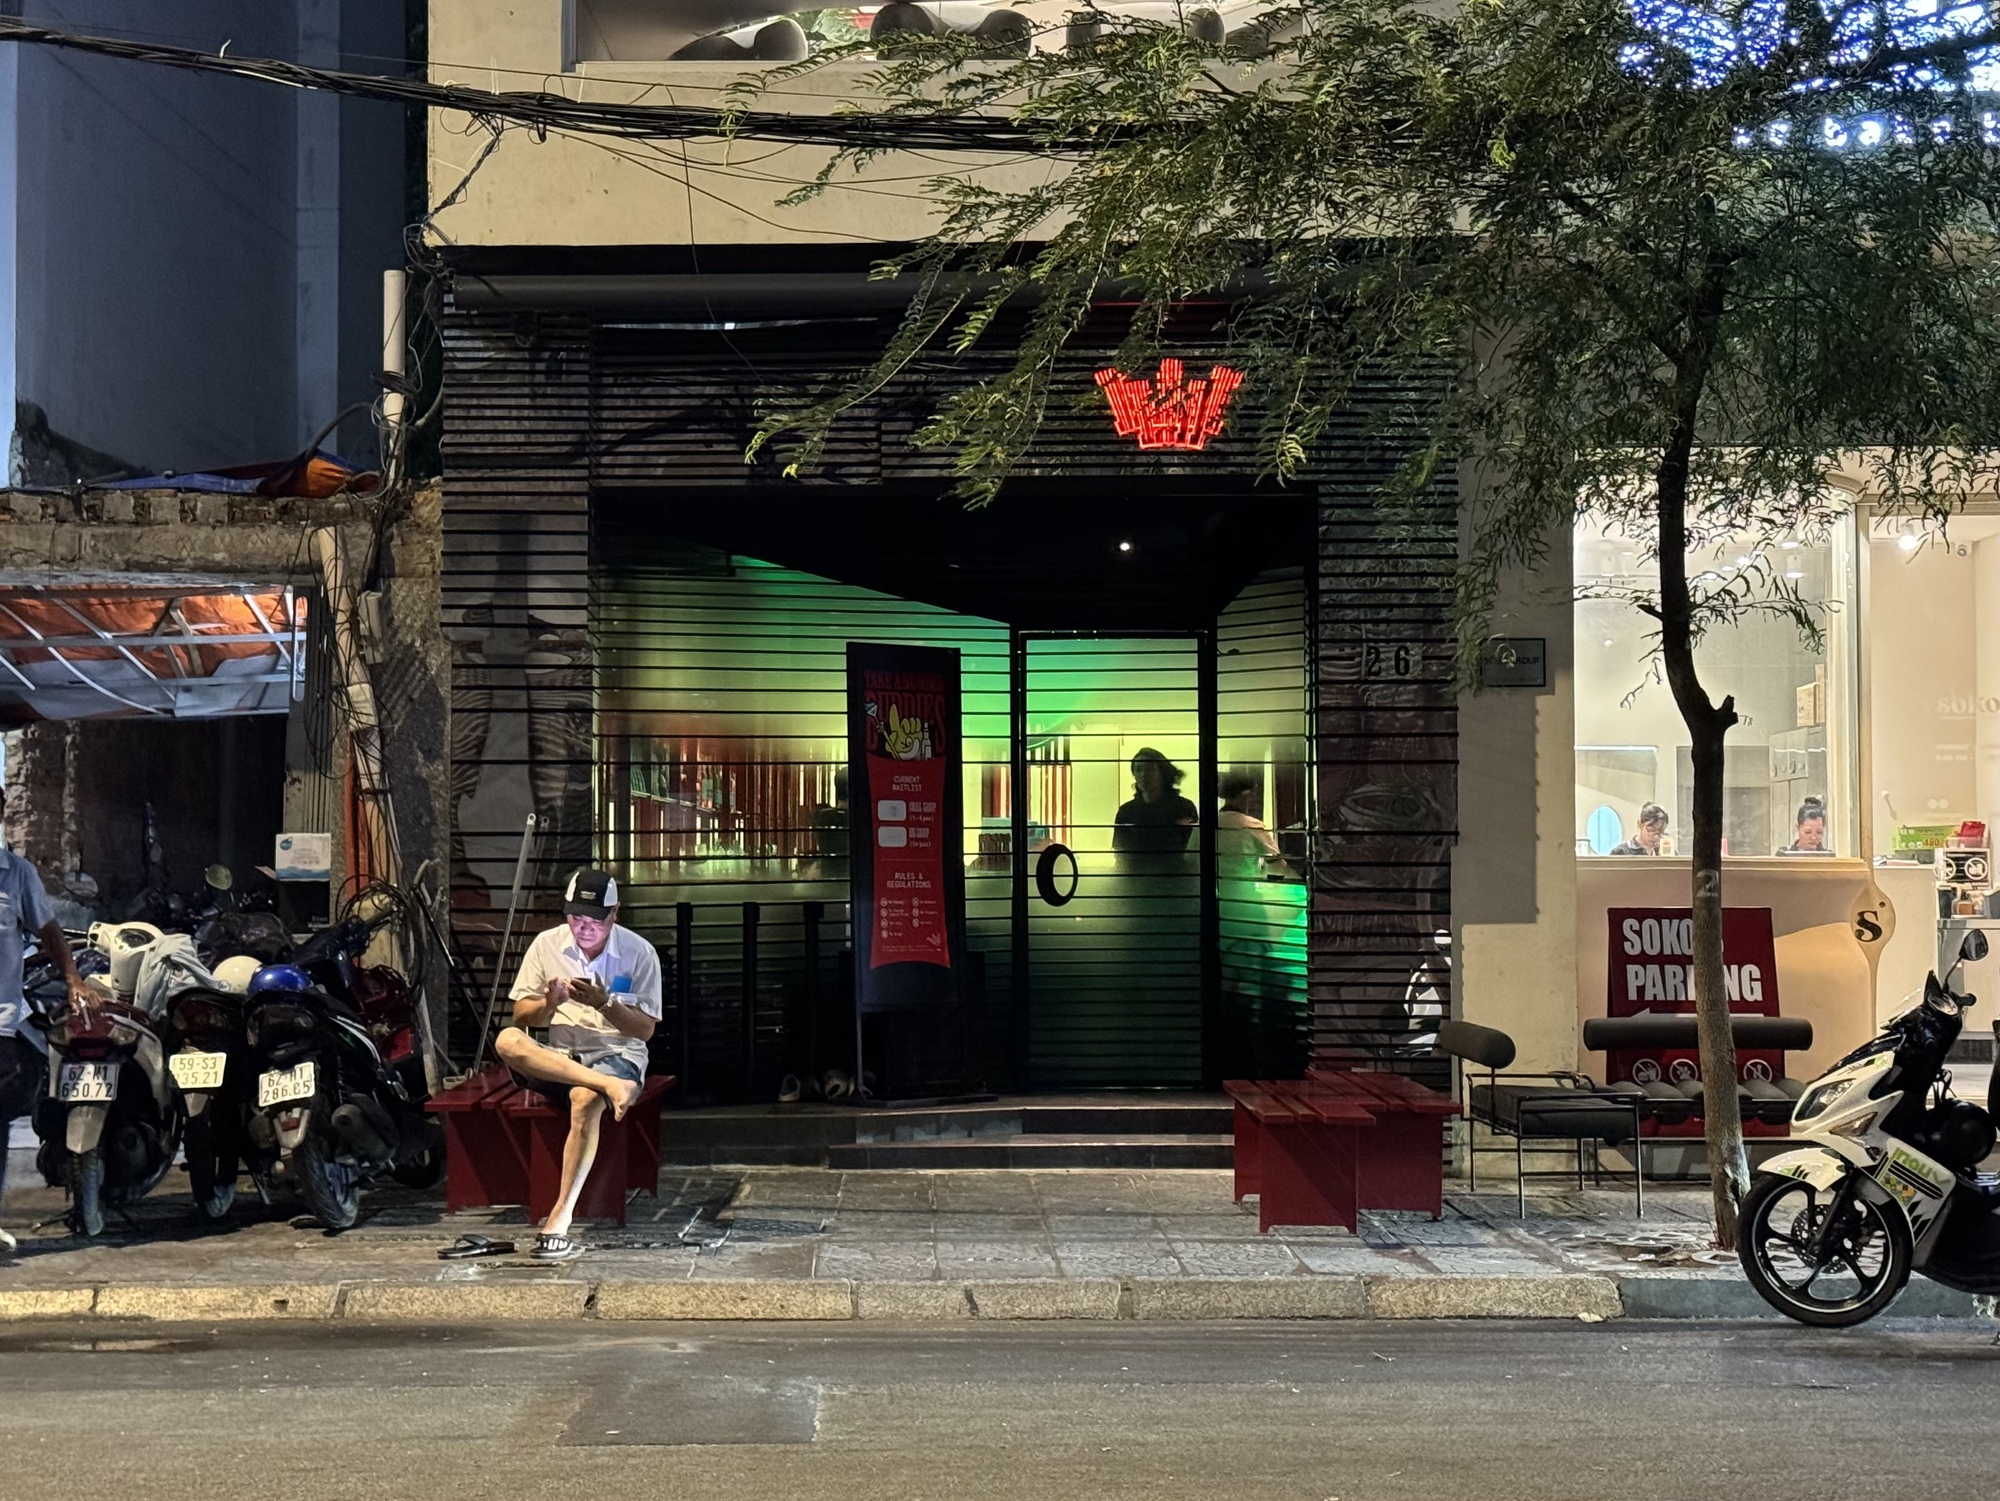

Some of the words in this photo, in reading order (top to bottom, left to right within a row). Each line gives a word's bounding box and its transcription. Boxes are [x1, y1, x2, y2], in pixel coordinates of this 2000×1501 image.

[1366, 645, 1410, 676] 26
[886, 880, 931, 888] REGULATIONS
[895, 872, 915, 880] RULES
[1855, 910, 1883, 942] S
[1626, 963, 1763, 1002] PARNG
[179, 1057, 217, 1070] 59-S3
[62, 1082, 113, 1098] 650.72
